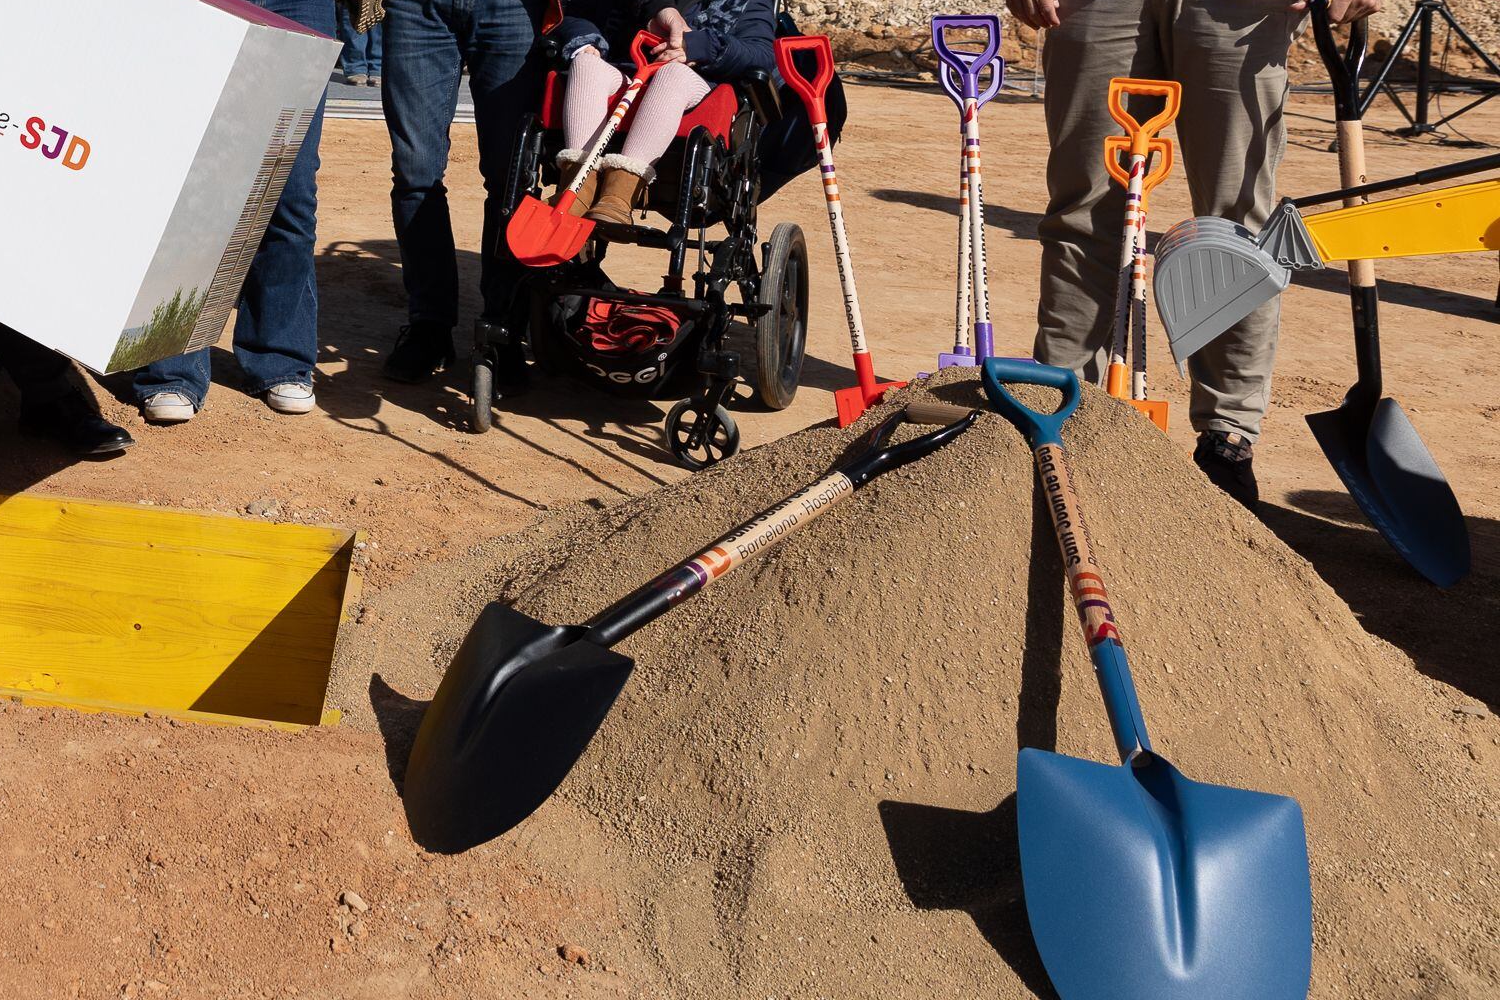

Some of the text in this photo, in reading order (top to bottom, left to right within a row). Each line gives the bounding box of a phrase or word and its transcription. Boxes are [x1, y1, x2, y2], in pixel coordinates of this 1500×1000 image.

[19, 116, 91, 171] SJD
[1046, 474, 1060, 492] de
[737, 473, 853, 560] Barcelona Hospital
[1051, 494, 1071, 532] Joan
[1061, 532, 1081, 569] Sant
